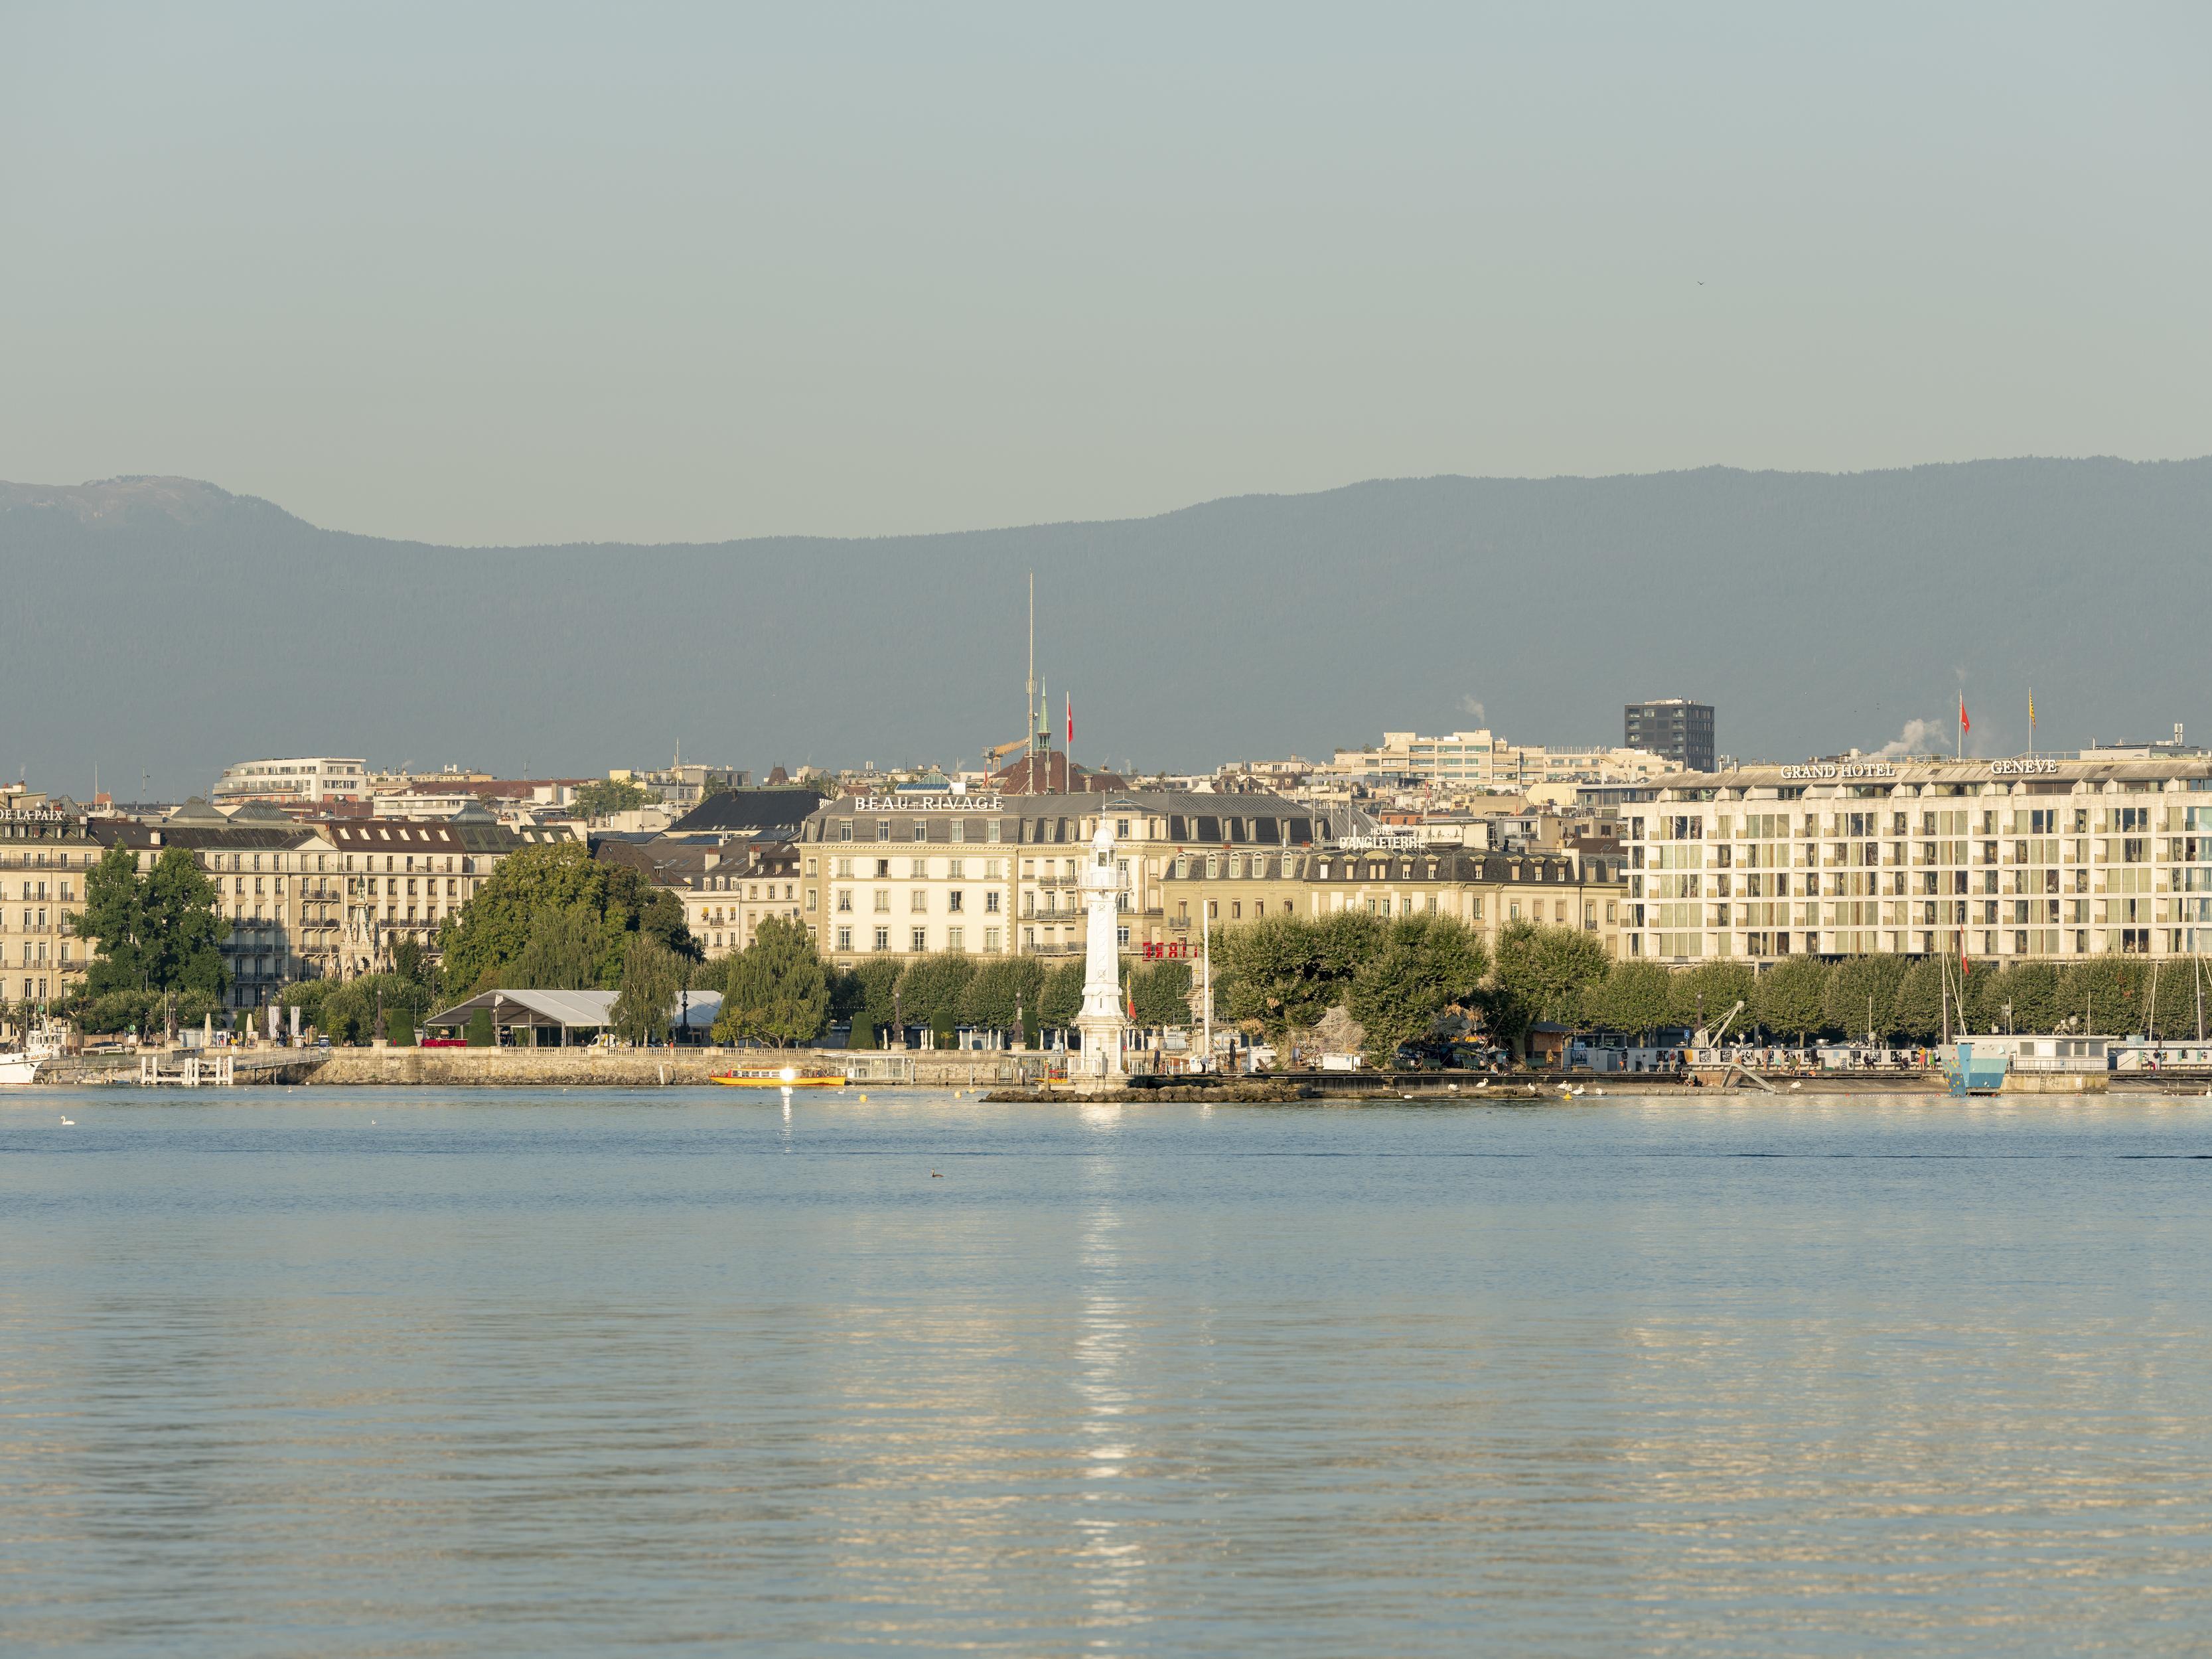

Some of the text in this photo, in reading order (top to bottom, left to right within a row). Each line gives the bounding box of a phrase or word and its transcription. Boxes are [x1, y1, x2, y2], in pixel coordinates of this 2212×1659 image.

[1781, 763, 1896, 778] GRAND HOTEL
[17, 809, 31, 820] LA
[35, 810, 63, 821] PAIX
[1339, 836, 1426, 849] D'ANGLETERRE
